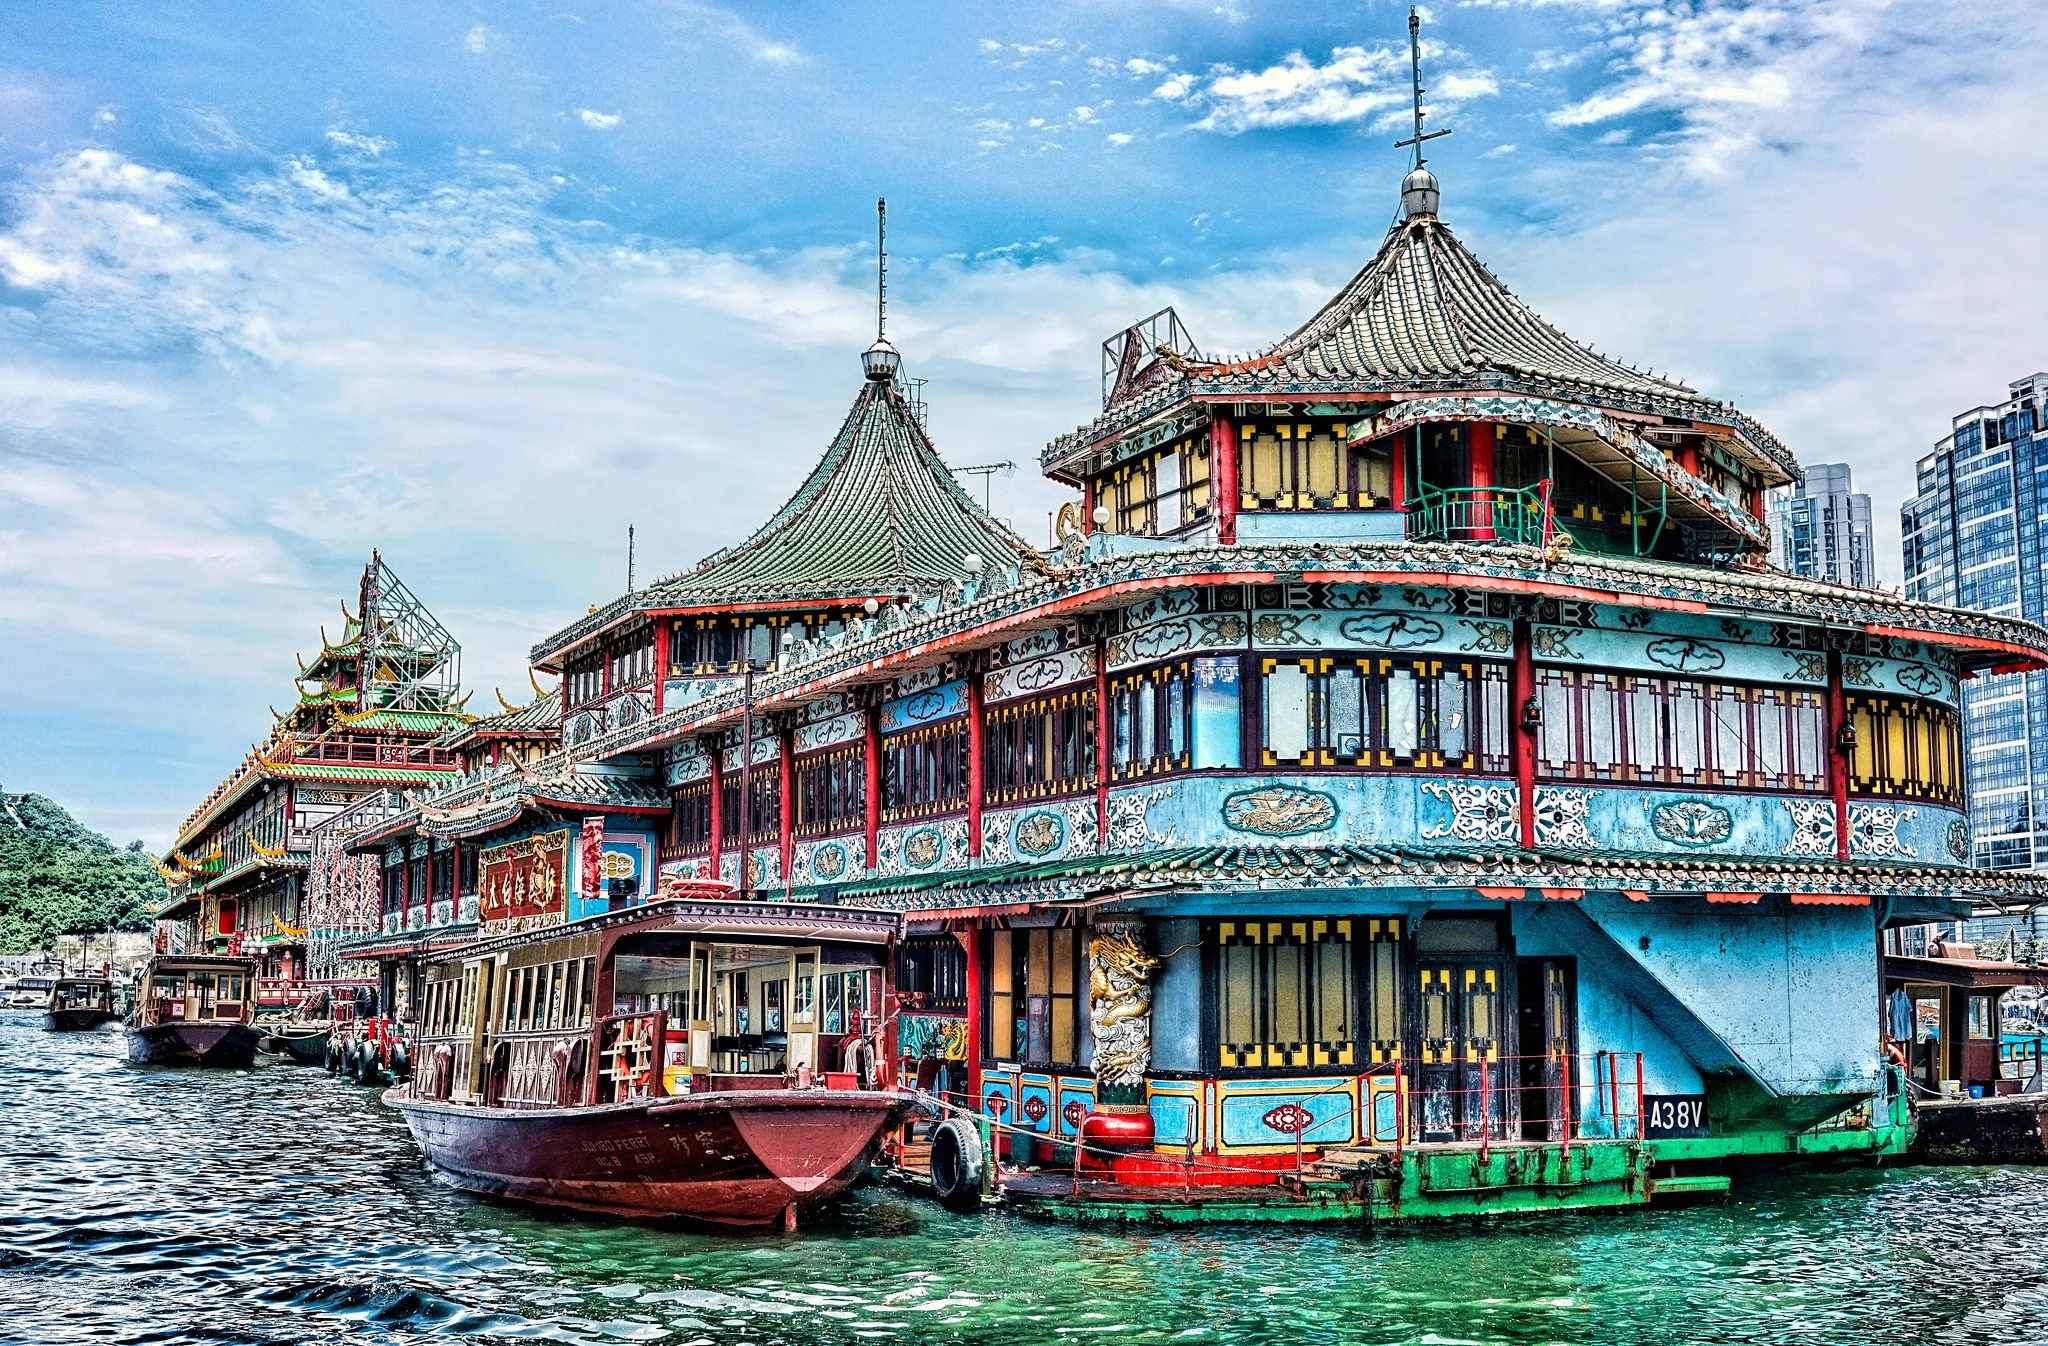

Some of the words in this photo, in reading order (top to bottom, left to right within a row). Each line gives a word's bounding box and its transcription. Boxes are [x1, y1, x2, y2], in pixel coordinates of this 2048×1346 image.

[1650, 1100, 1703, 1129] A38V
[581, 1140, 615, 1152] JUMBO
[614, 1135, 651, 1151] FERRY
